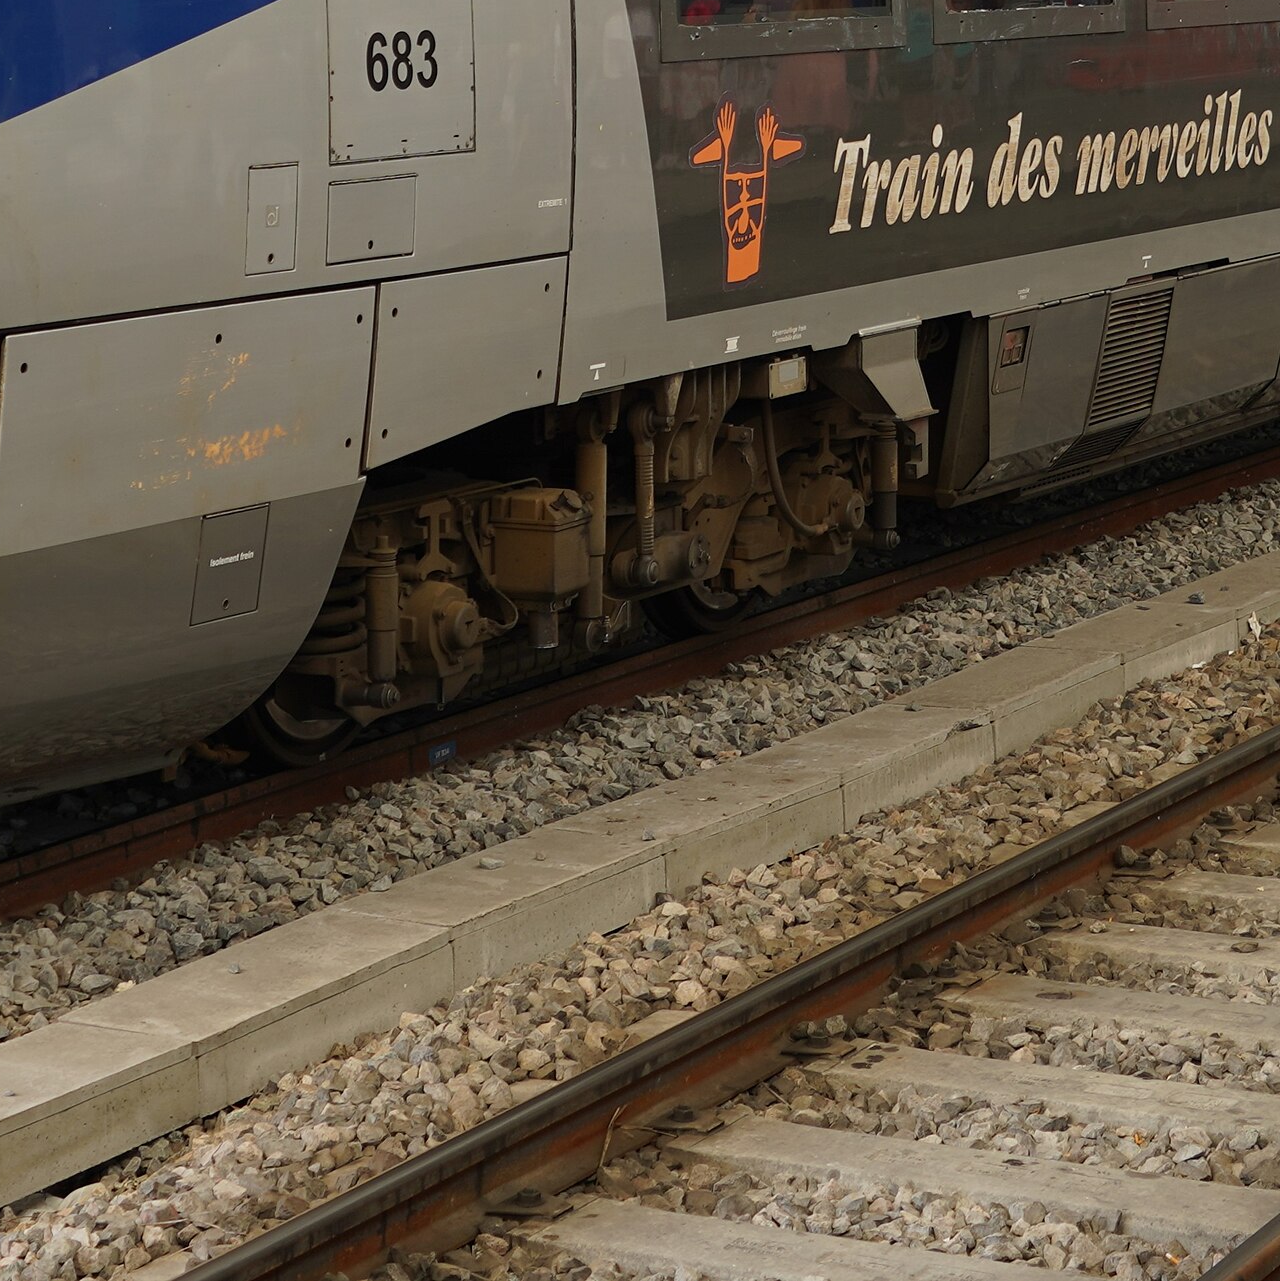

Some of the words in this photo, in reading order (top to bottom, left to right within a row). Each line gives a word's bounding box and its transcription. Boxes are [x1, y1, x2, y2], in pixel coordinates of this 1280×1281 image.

[366, 29, 438, 92] 683
[828, 123, 974, 234] Train
[986, 112, 1064, 208] des
[1074, 89, 1274, 196] merveilles
